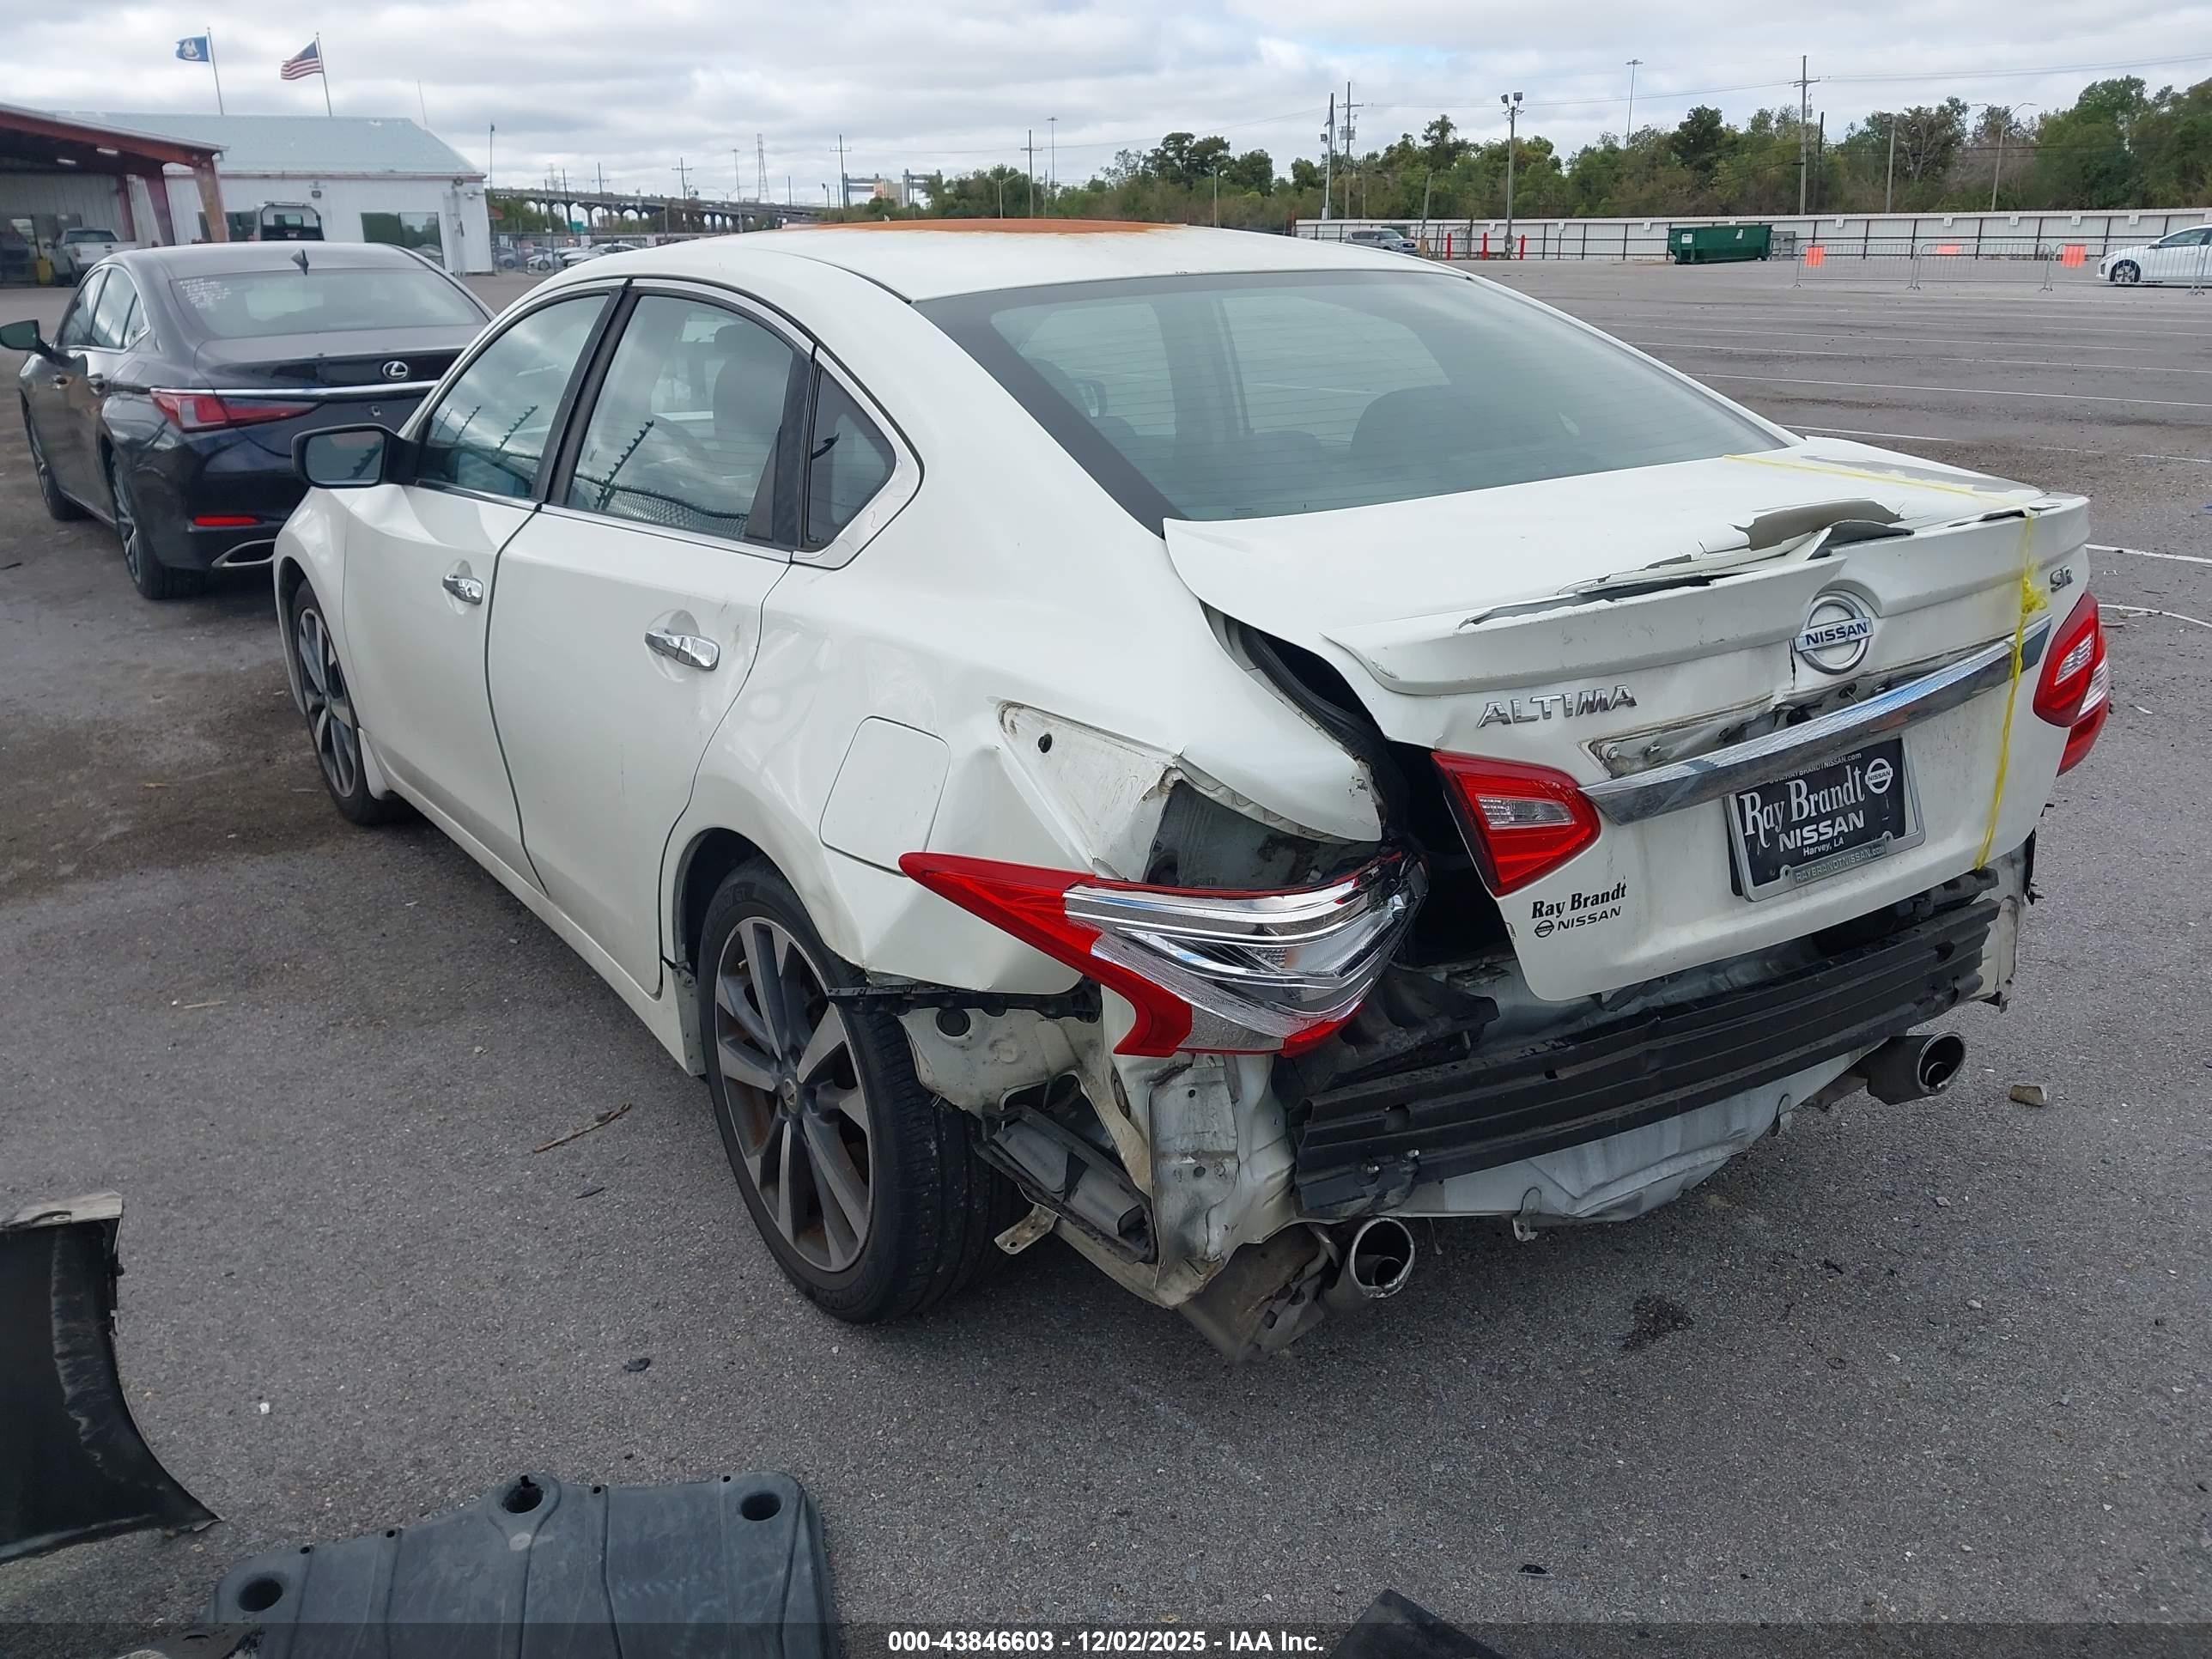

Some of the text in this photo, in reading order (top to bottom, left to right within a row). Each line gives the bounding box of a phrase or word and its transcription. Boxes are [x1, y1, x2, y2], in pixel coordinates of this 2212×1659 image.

[1805, 622, 1869, 646] NISSAN
[1477, 684, 1638, 728] ALTIMA
[1868, 770, 1891, 782] NISSAN
[1740, 764, 1865, 849] Ray Brandt
[1778, 810, 1865, 853] NISSAN
[1803, 836, 1844, 857] Harvey, LA
[1531, 882, 1627, 920] Ray Brandt
[1557, 905, 1622, 932] NISSAN
